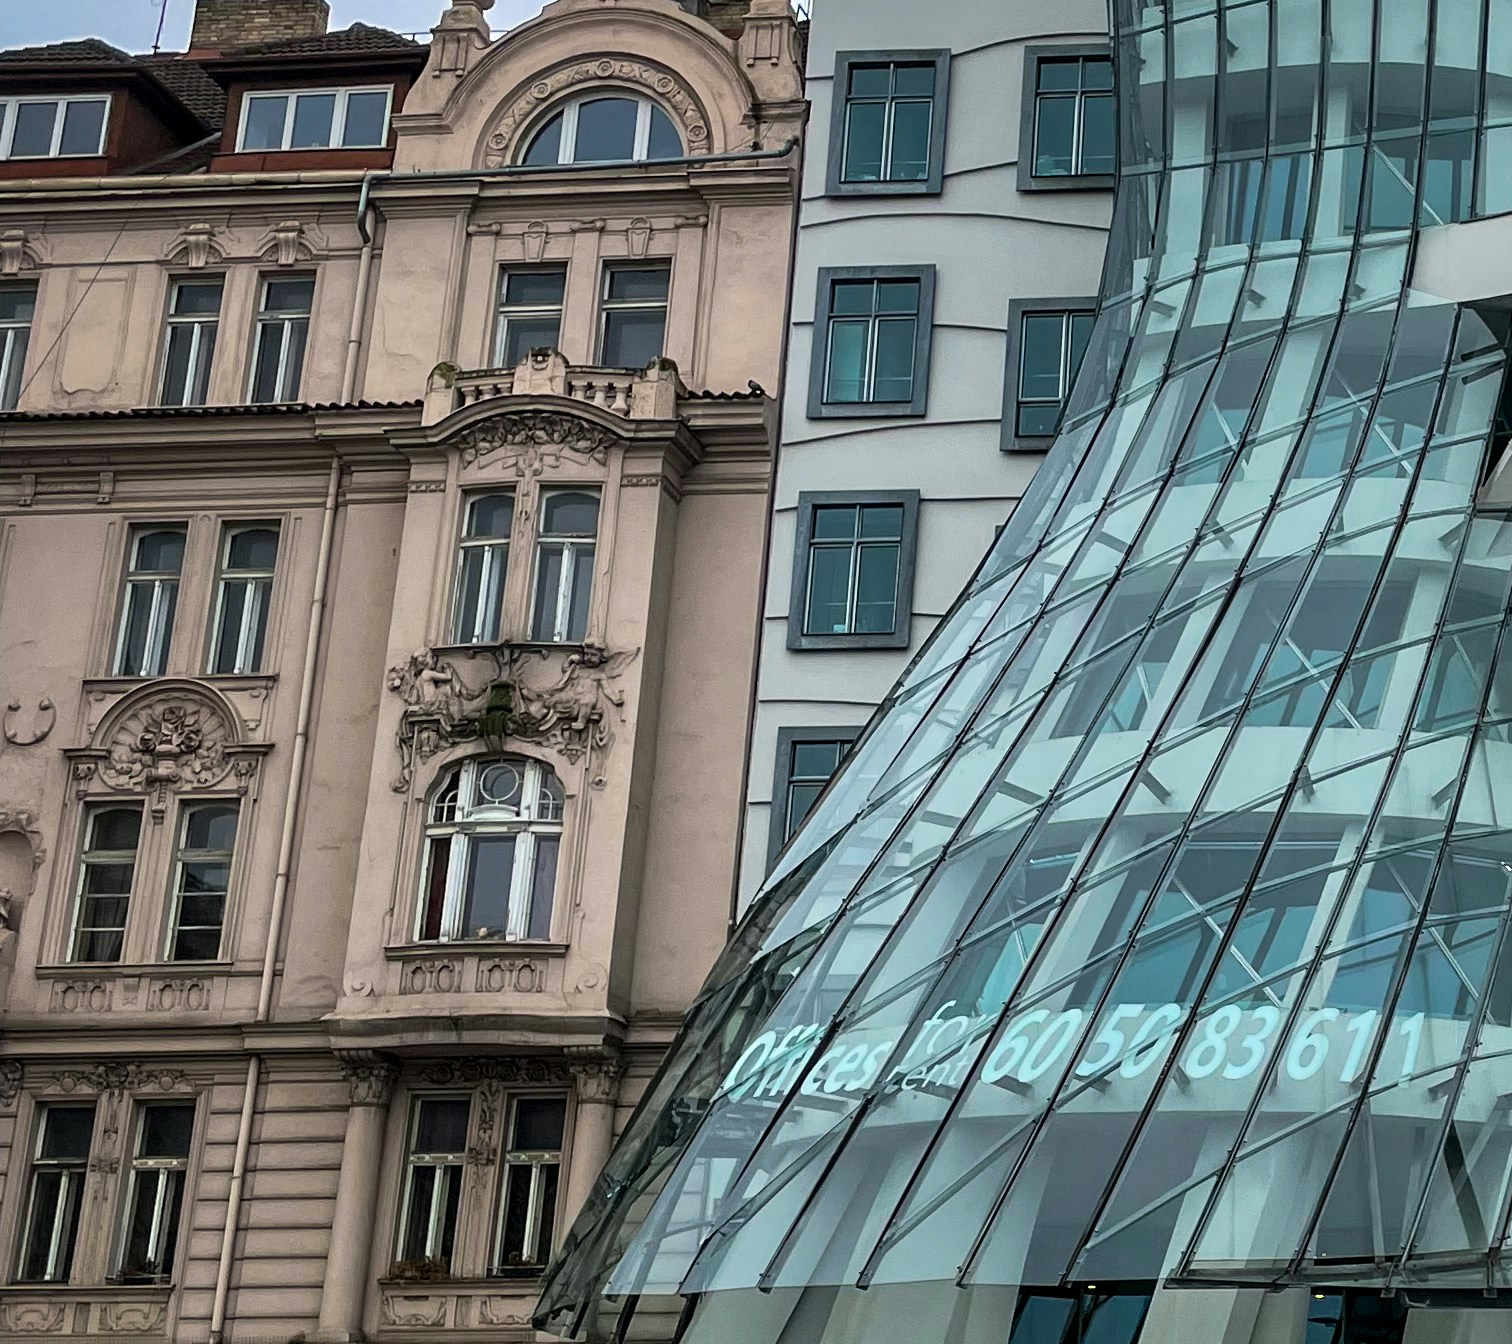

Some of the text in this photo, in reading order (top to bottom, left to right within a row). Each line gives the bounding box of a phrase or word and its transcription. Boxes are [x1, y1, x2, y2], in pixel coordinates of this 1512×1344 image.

[723, 1023, 893, 1103] Offices
[981, 1008, 1083, 1084] 60
[1074, 1003, 1182, 1079] 50
[1185, 1004, 1280, 1080] 83
